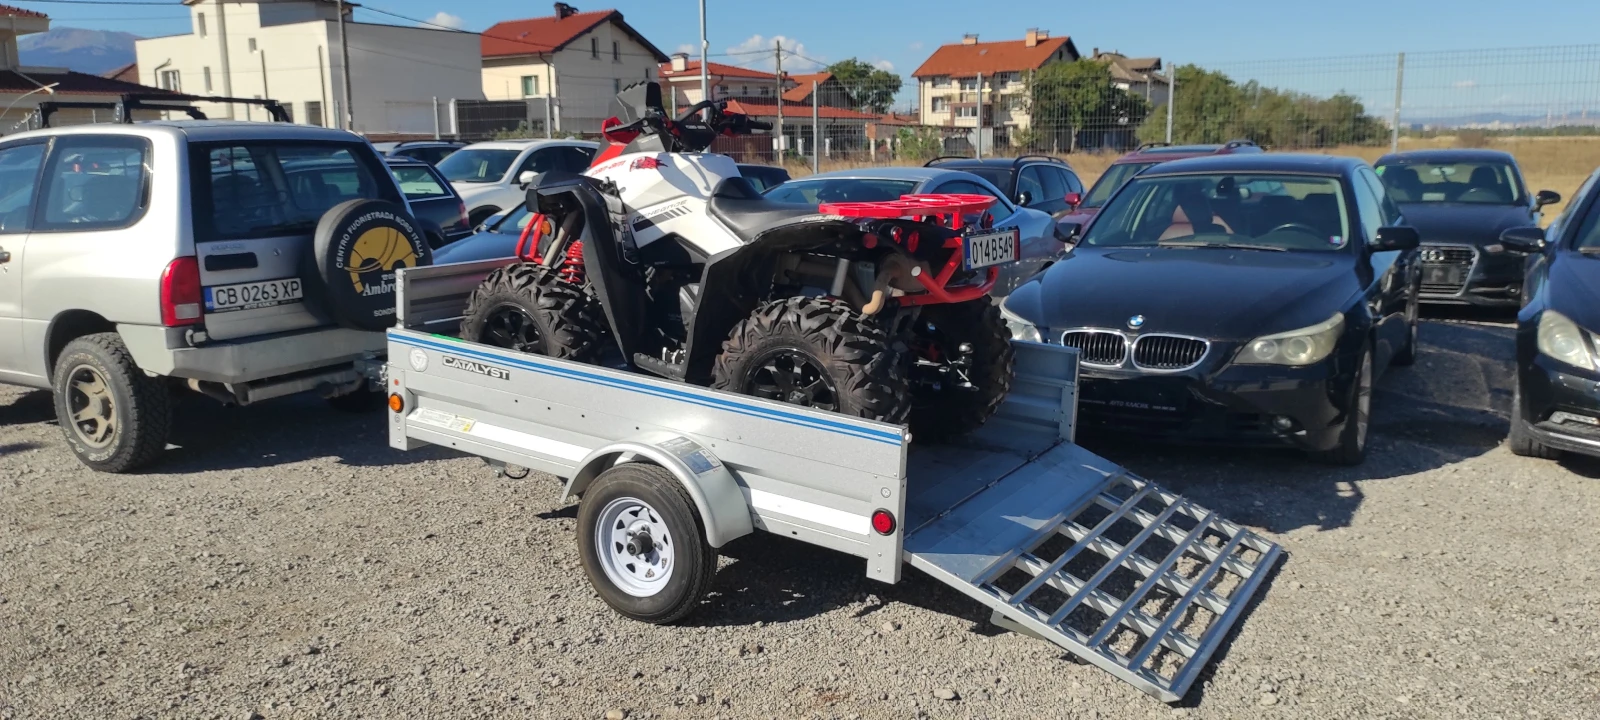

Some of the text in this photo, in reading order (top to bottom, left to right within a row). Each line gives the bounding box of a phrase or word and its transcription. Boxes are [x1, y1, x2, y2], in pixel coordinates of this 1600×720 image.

[336, 211, 425, 269] CENTRO FUORISTRADA NORD ITALIA
[215, 288, 238, 306] CB
[241, 283, 279, 303] 0263
[281, 280, 300, 298] XP
[442, 356, 510, 379] CATALYST
